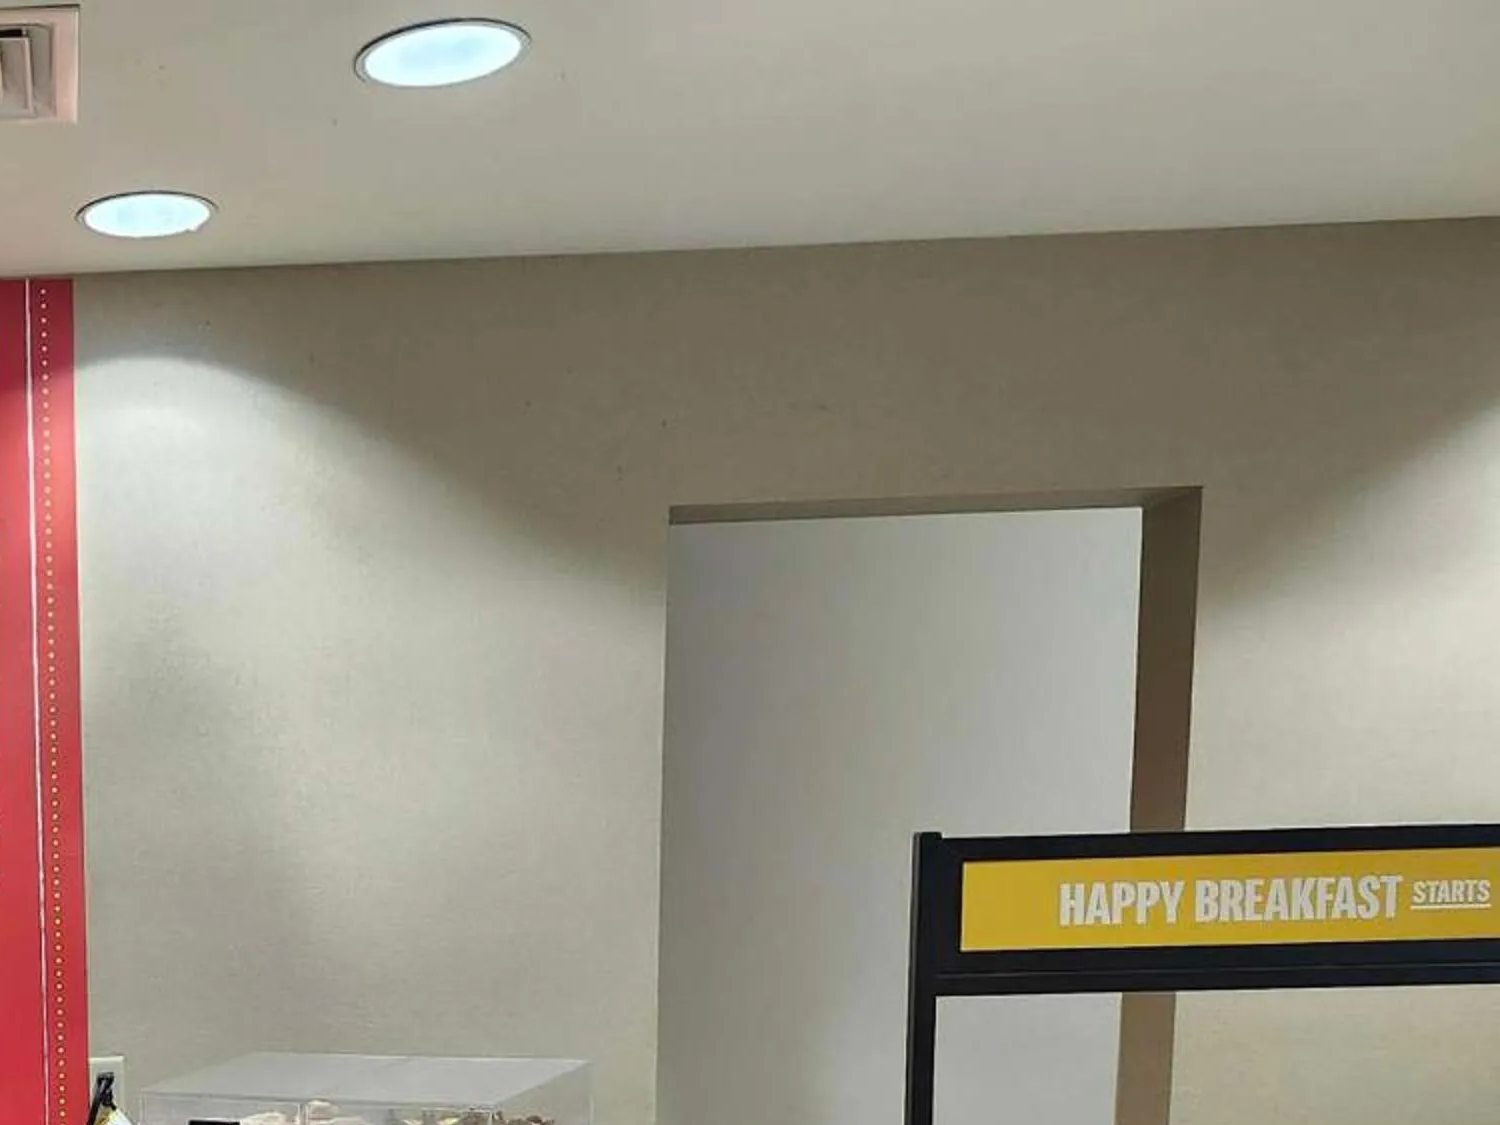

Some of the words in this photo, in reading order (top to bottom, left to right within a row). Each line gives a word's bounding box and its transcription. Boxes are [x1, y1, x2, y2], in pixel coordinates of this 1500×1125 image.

[1058, 881, 1185, 926] HAPPY
[1194, 875, 1403, 922] BREAKFAST
[1411, 879, 1491, 903] STARTS
